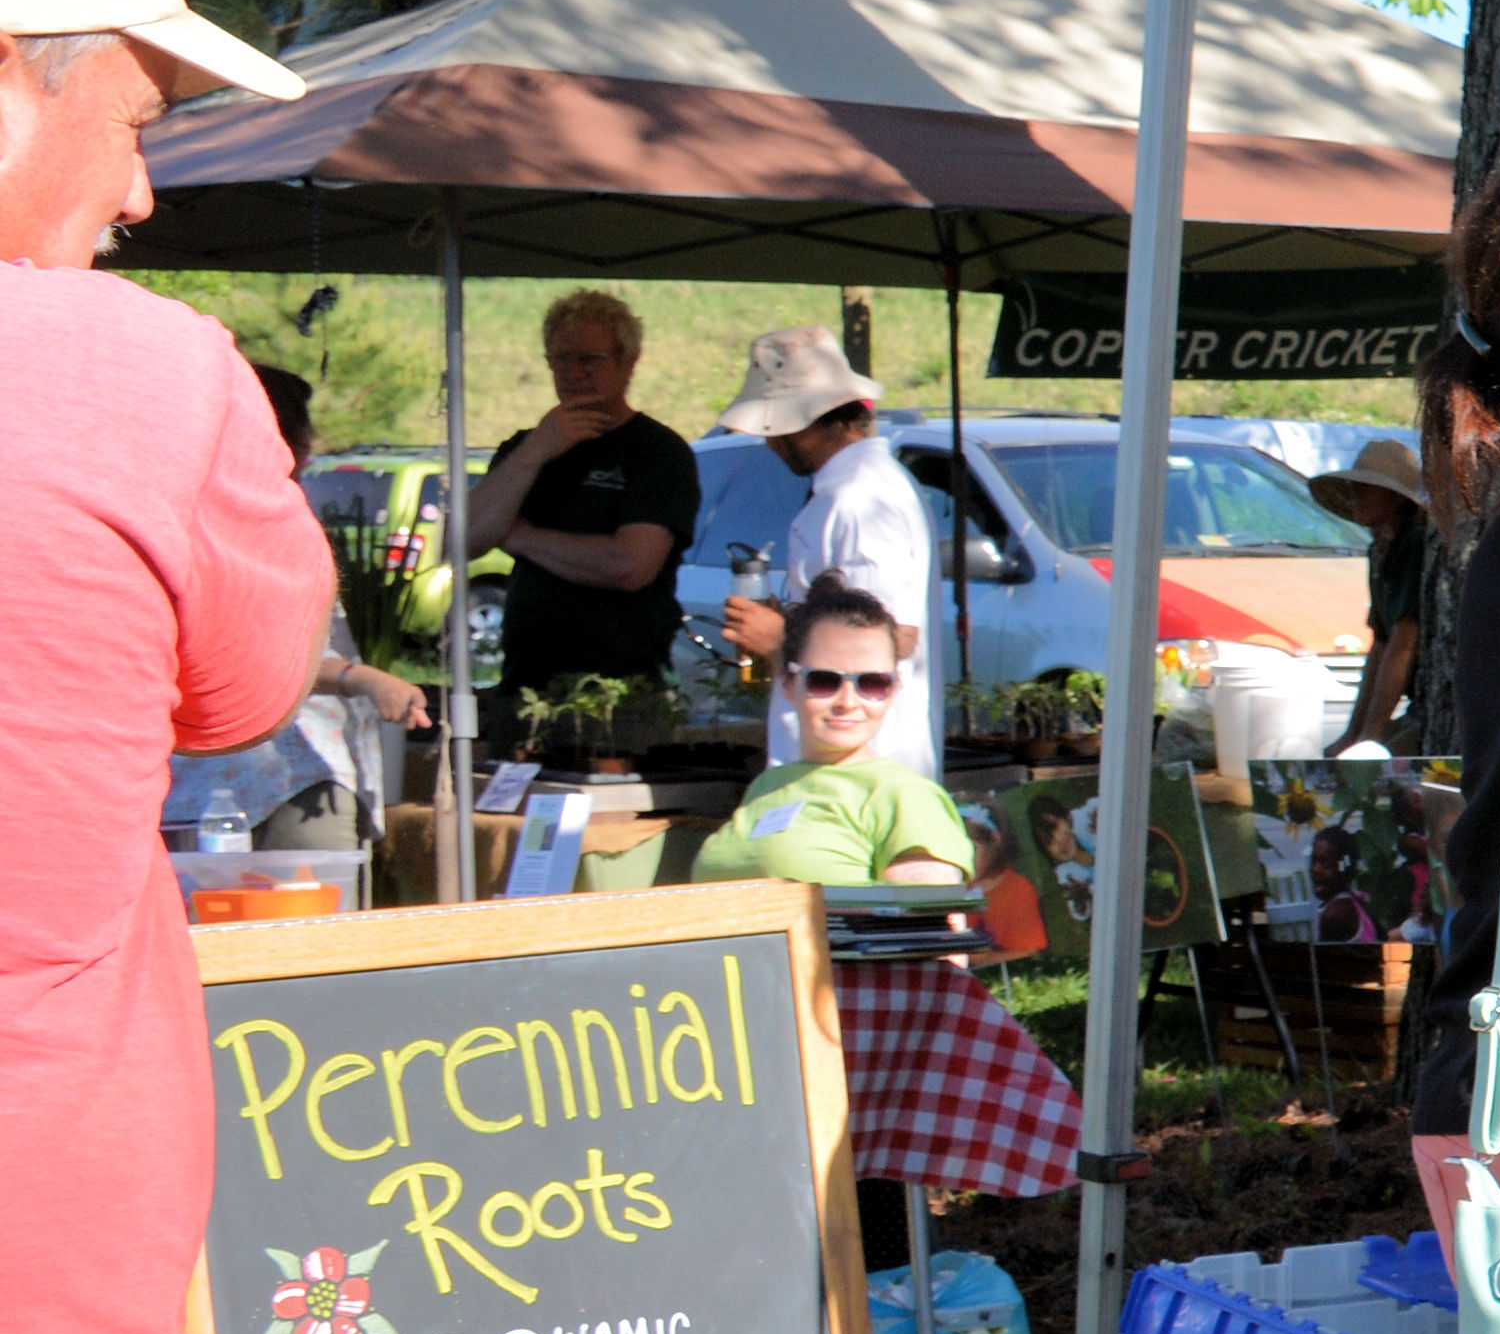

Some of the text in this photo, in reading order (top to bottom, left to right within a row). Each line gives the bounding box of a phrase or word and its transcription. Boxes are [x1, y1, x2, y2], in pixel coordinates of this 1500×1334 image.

[1015, 324, 1438, 368] COPR CRICKET
[215, 954, 755, 1180] Perennial
[368, 1149, 672, 1304] Roots
